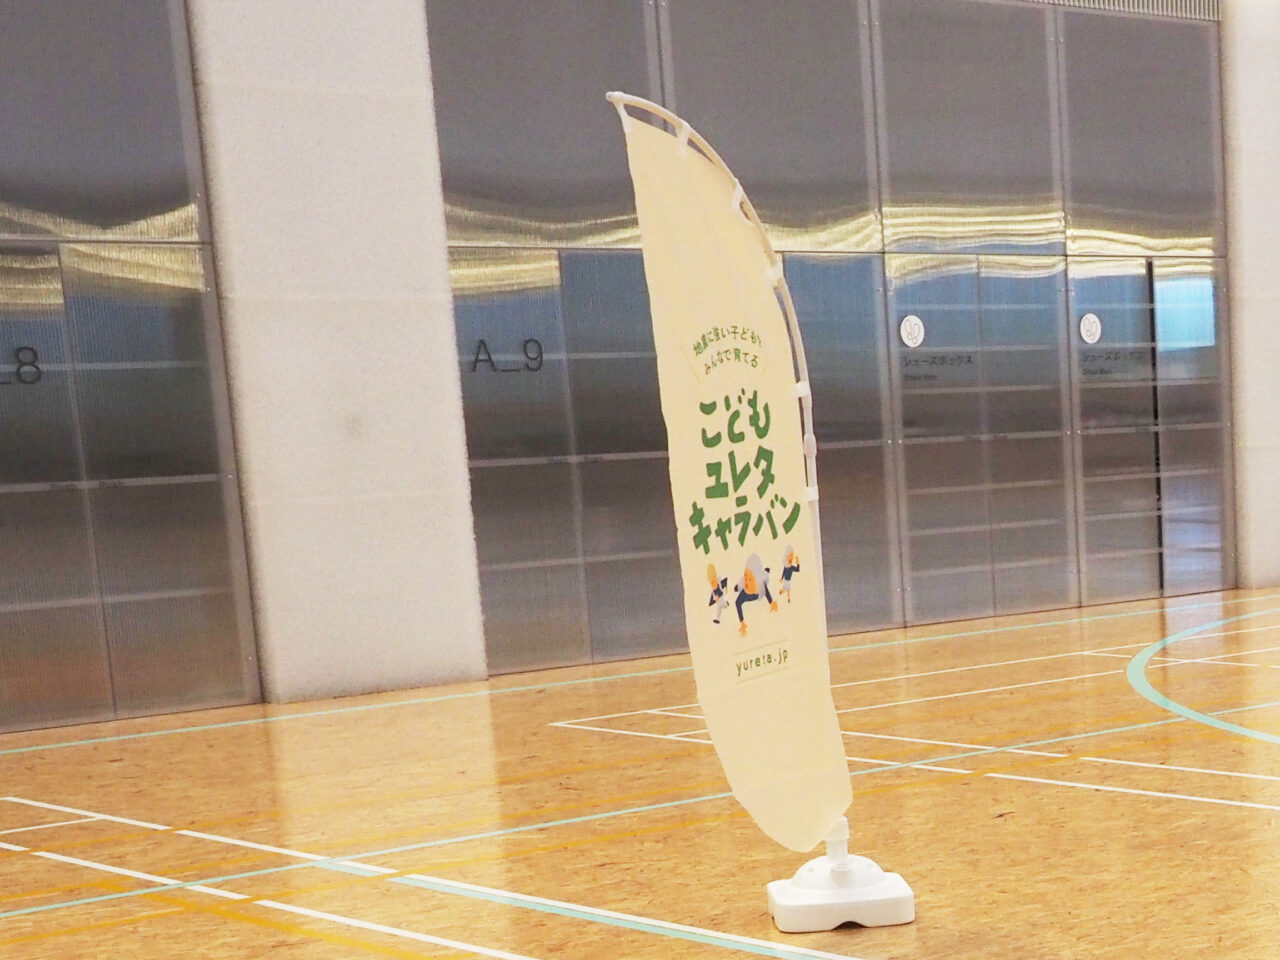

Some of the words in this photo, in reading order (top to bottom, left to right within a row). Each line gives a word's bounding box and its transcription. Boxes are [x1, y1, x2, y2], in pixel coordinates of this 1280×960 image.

[471, 339, 545, 374] A_9
[704, 348, 759, 375] みんなで育てる
[699, 388, 771, 449] こども
[705, 445, 776, 499] ユレタ
[689, 493, 800, 555] キャラバン
[736, 648, 789, 677] yureta.jp
